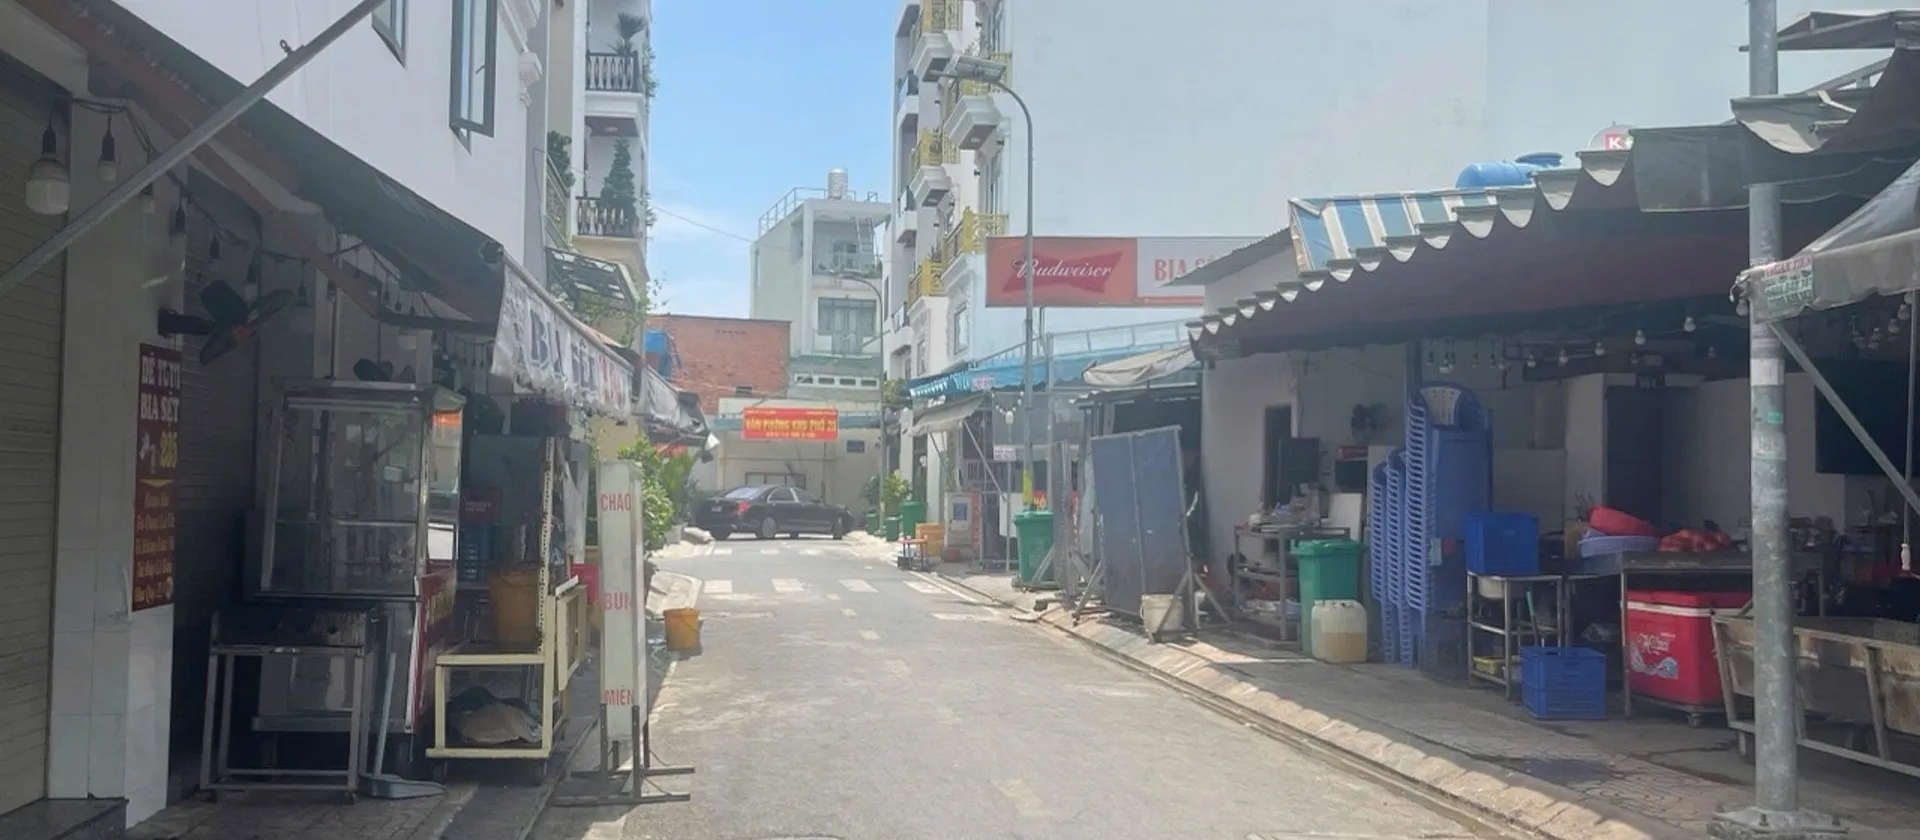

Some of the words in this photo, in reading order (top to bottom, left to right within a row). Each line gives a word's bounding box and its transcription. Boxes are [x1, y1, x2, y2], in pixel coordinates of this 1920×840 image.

[1012, 259, 1113, 278] Budweiser
[1155, 259, 1186, 281] BIA
[140, 392, 159, 420] BIA
